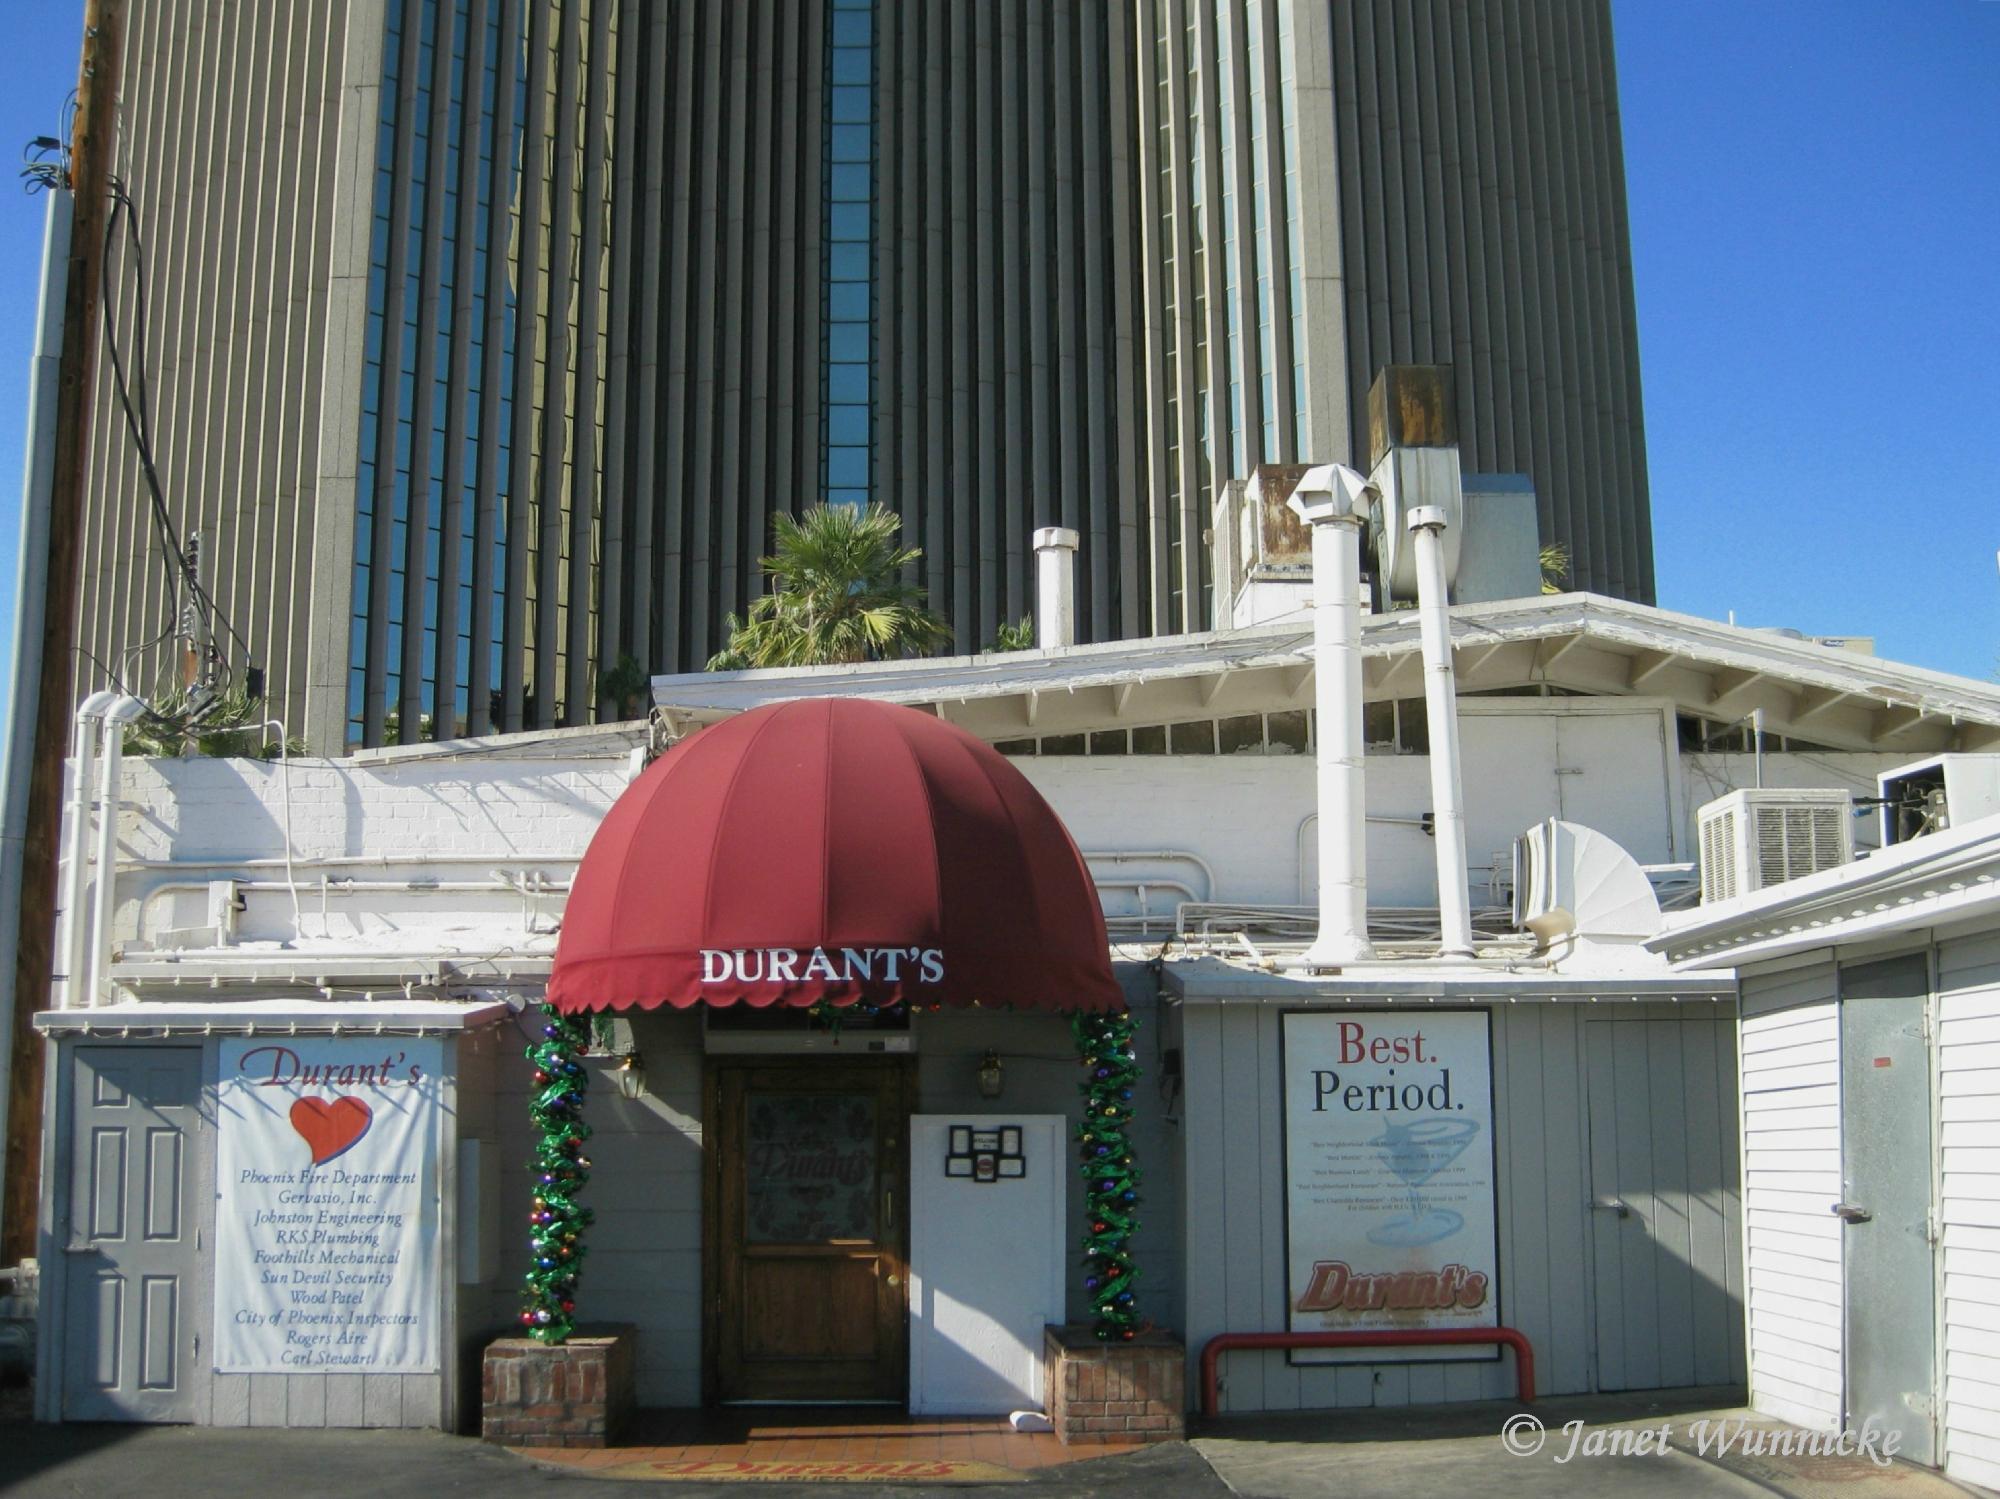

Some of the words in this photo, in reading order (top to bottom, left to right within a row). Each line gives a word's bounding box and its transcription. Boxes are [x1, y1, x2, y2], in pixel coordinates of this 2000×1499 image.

[700, 945, 944, 983] DURANT'S
[1336, 1022, 1438, 1064] Best.
[240, 1046, 424, 1086] Durant's
[1310, 1068, 1464, 1112] Period.
[240, 1169, 295, 1184] Phoenix
[300, 1169, 329, 1184] Fire
[332, 1169, 416, 1187] Department
[278, 1190, 345, 1205] Gervasio,
[349, 1190, 377, 1204] Inc.
[254, 1209, 313, 1226] Johnston
[317, 1210, 402, 1228] Engineering
[276, 1230, 308, 1244] RKS
[311, 1230, 379, 1247] Plumbing
[254, 1250, 315, 1265] Foothills
[319, 1250, 400, 1265] Mechanical
[260, 1269, 288, 1284] Sun
[292, 1270, 331, 1284] Devil
[334, 1270, 394, 1288] Security
[1297, 1260, 1489, 1312] Durant's
[290, 1290, 326, 1304] Wood
[331, 1290, 364, 1305] Patel
[235, 1309, 265, 1327] City
[268, 1309, 284, 1327] of
[288, 1310, 343, 1325] Phoenix
[349, 1310, 418, 1328] Inspectors
[286, 1330, 331, 1347] Rogers
[281, 1350, 312, 1365] Carl
[315, 1350, 373, 1365] Stewart
